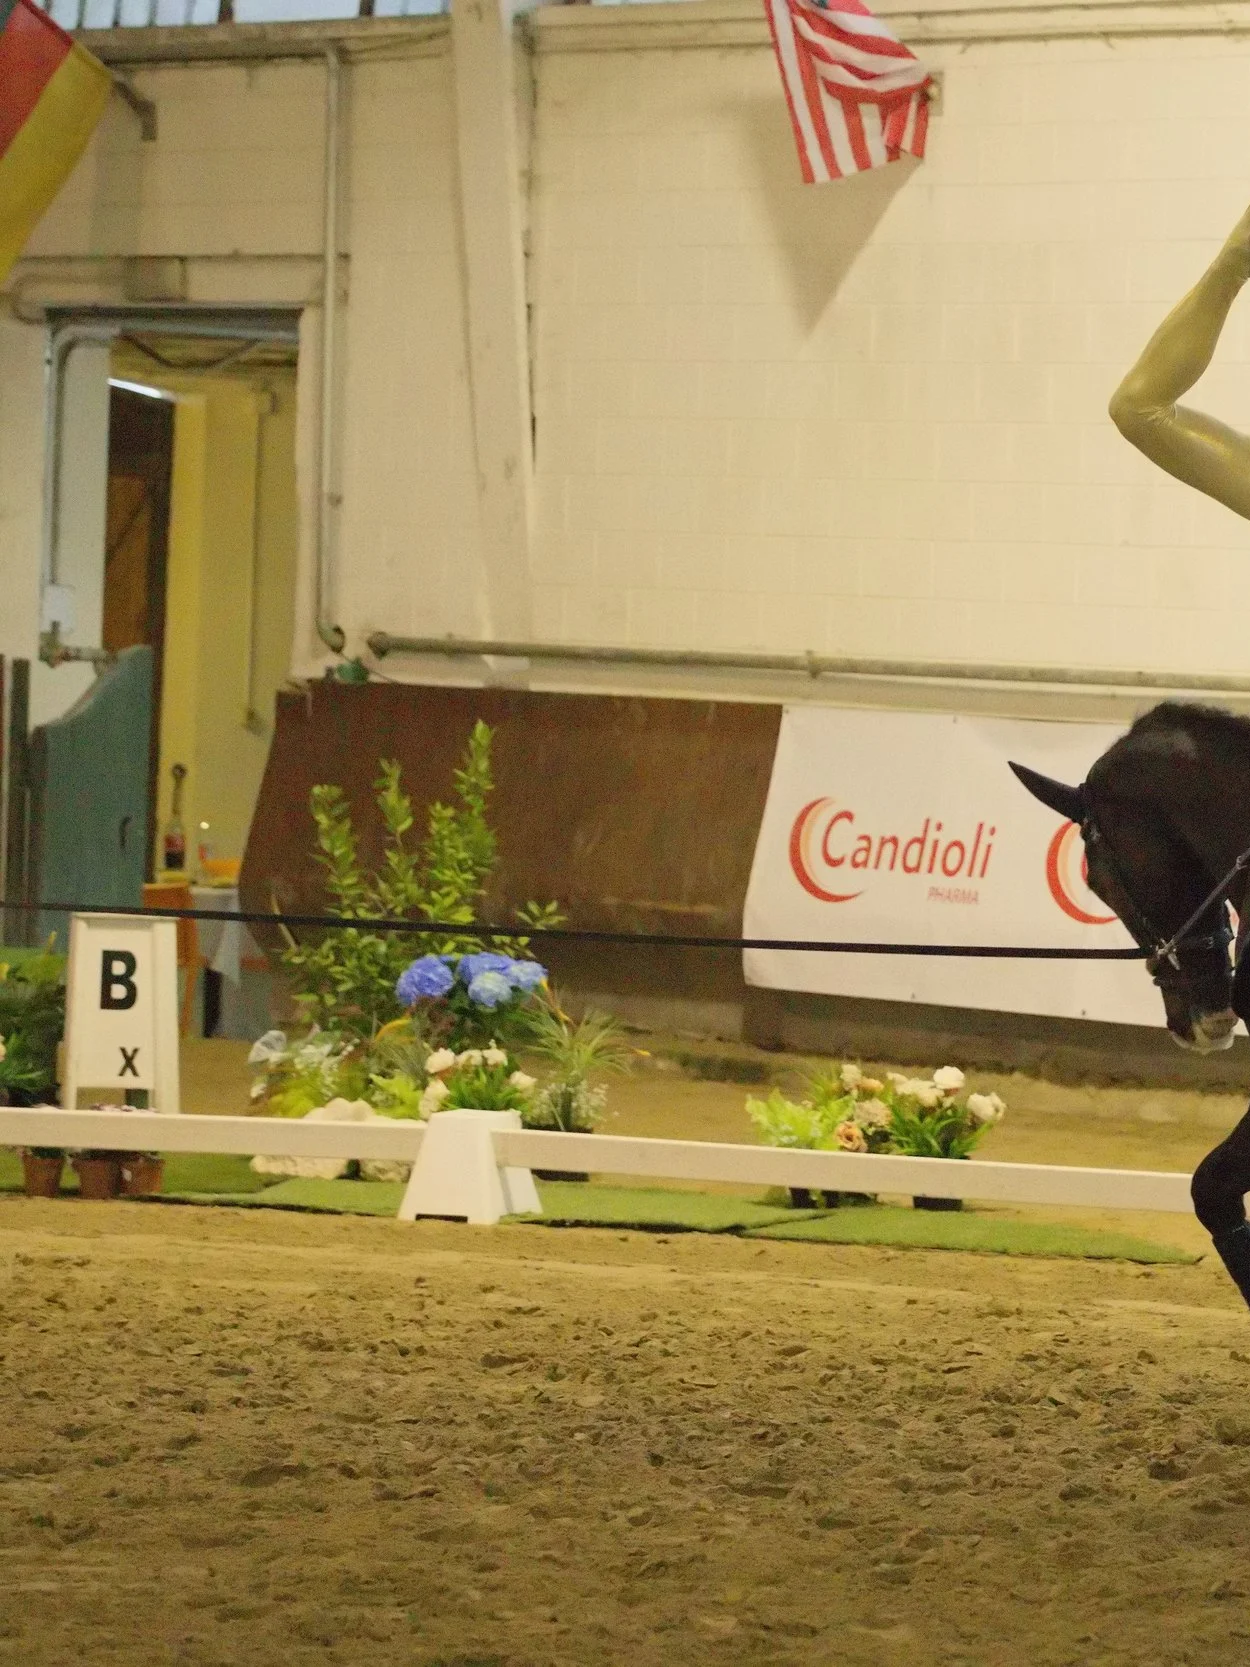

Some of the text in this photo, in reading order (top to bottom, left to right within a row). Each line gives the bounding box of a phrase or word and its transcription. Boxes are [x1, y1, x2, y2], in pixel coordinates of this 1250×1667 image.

[821, 810, 996, 878] Candioli
[100, 949, 138, 1011] B
[117, 1046, 140, 1078] X
